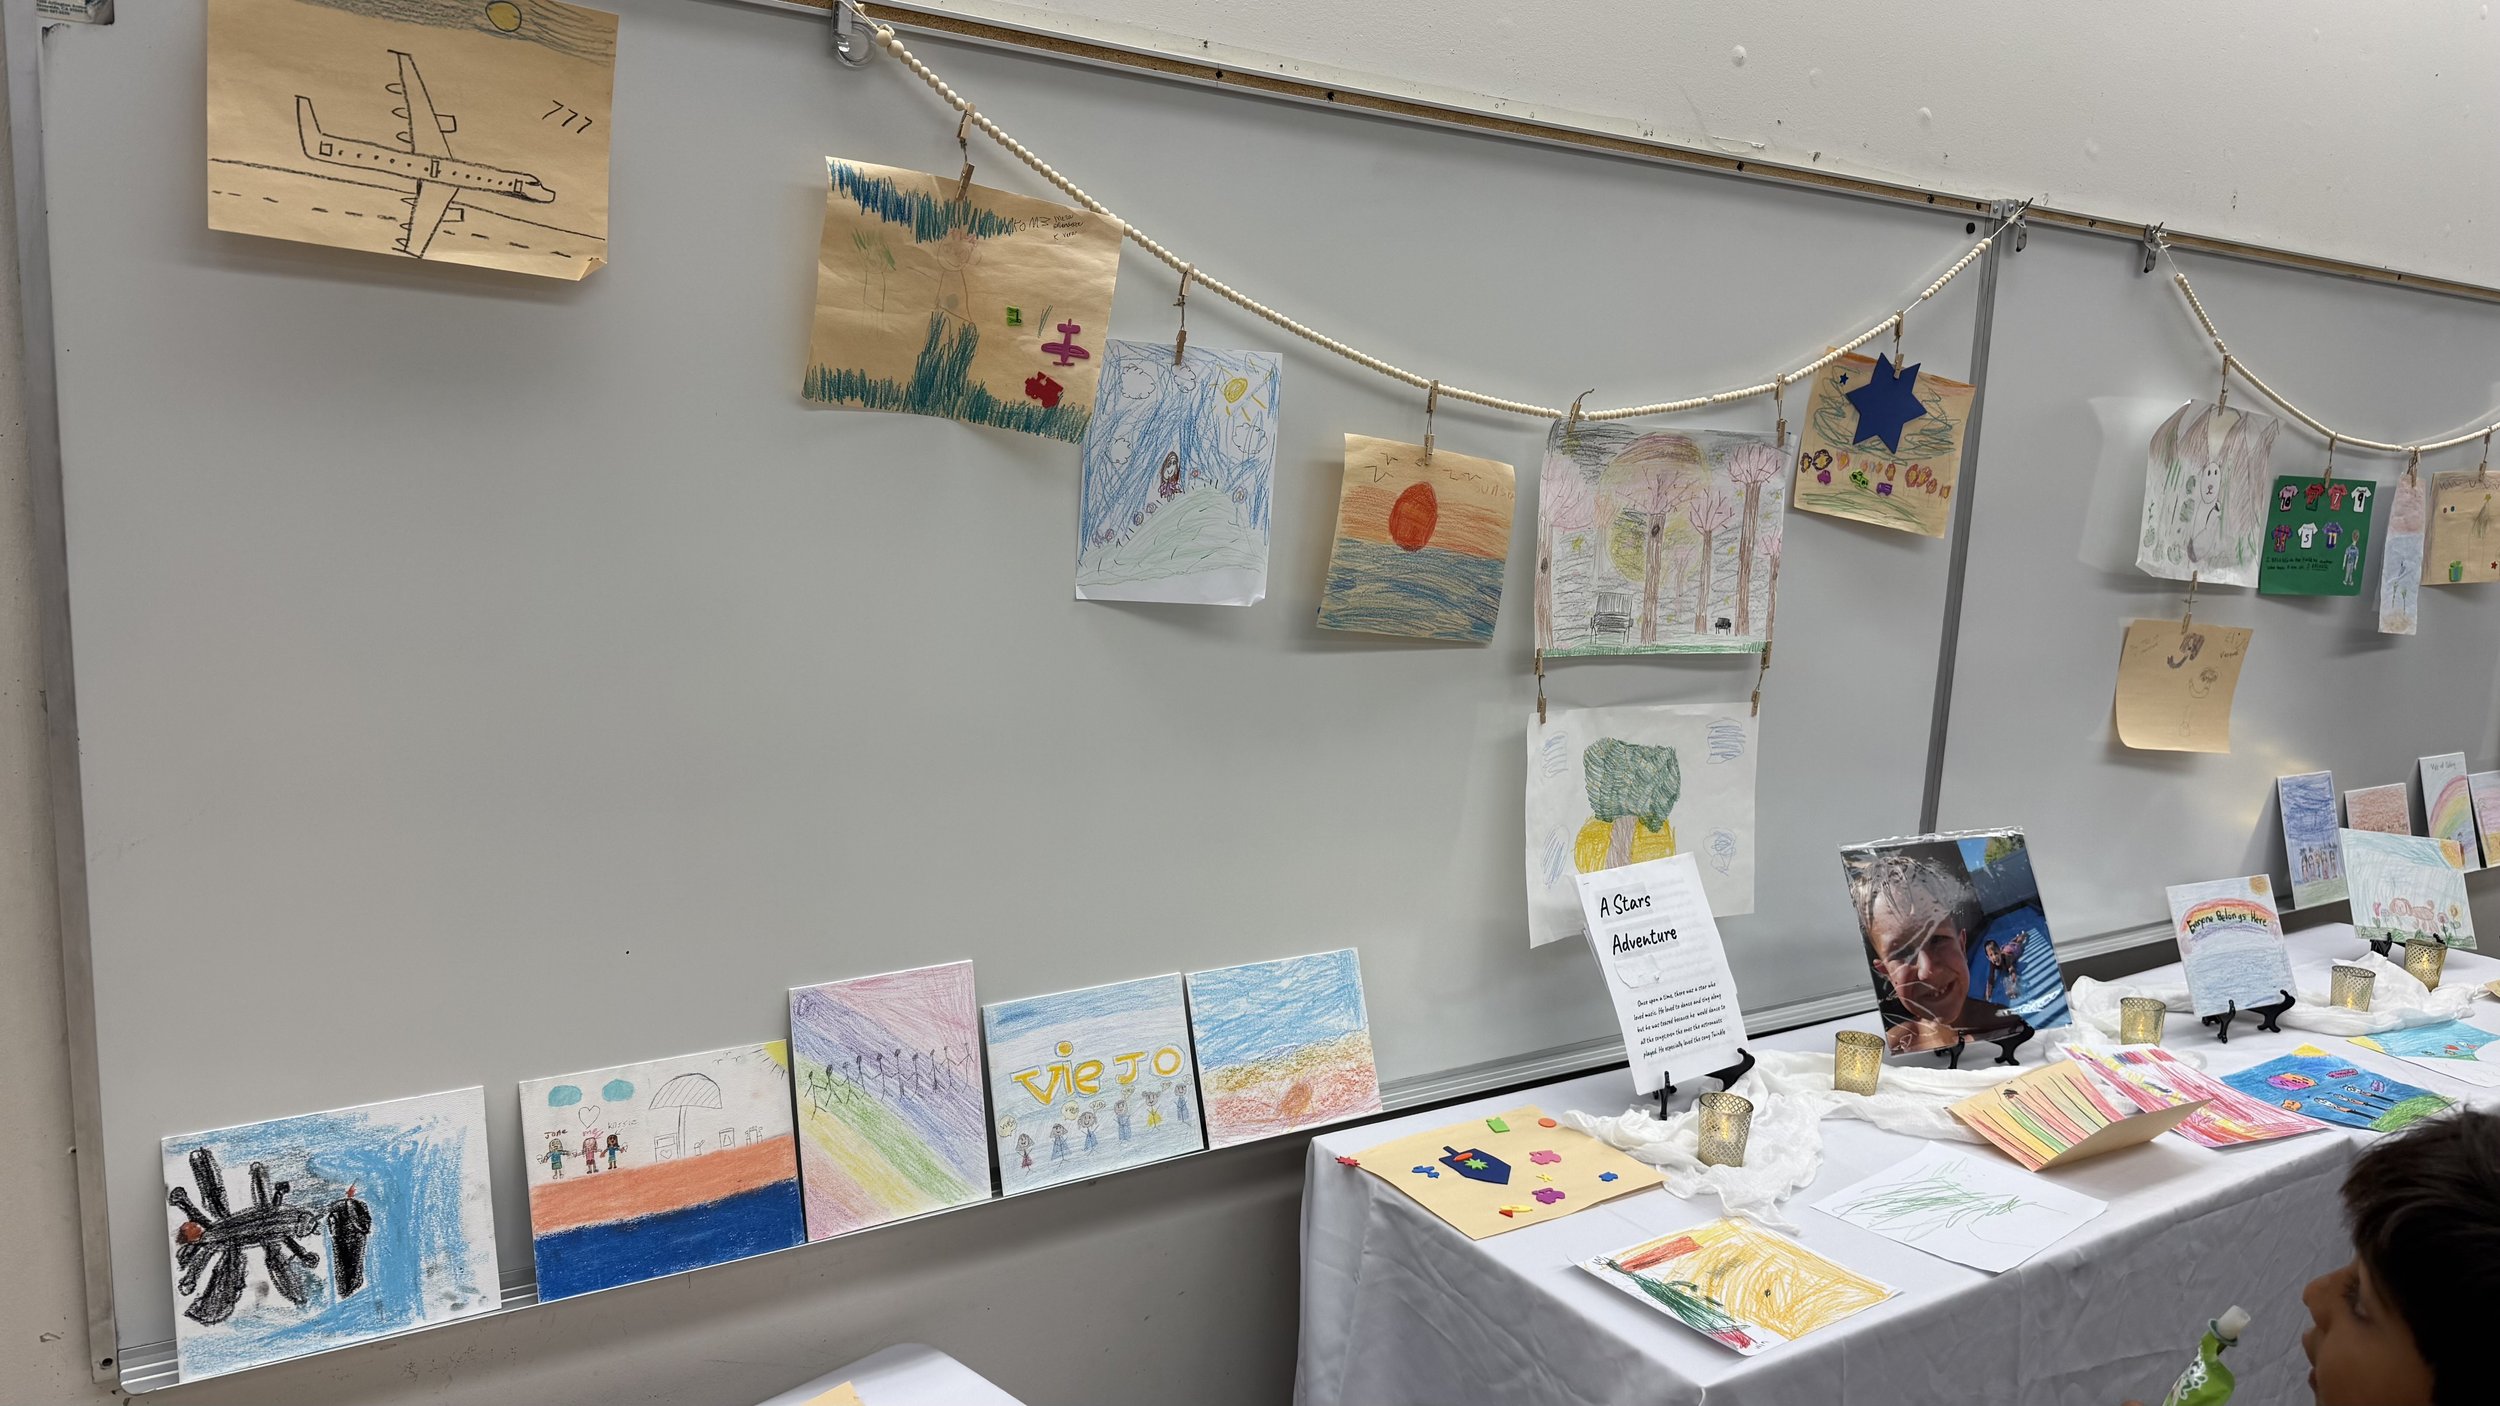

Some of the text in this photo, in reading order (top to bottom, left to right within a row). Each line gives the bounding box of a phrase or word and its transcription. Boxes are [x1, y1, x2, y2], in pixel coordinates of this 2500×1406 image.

[541, 99, 593, 134] 777
[1600, 893, 1651, 918] A Stars
[1612, 928, 1677, 956] Adventure
[1634, 1012, 1644, 1020] loved
[1665, 1004, 1674, 1012] loved
[1697, 1008, 1708, 1016] would
[1684, 1038, 1693, 1046] loved
